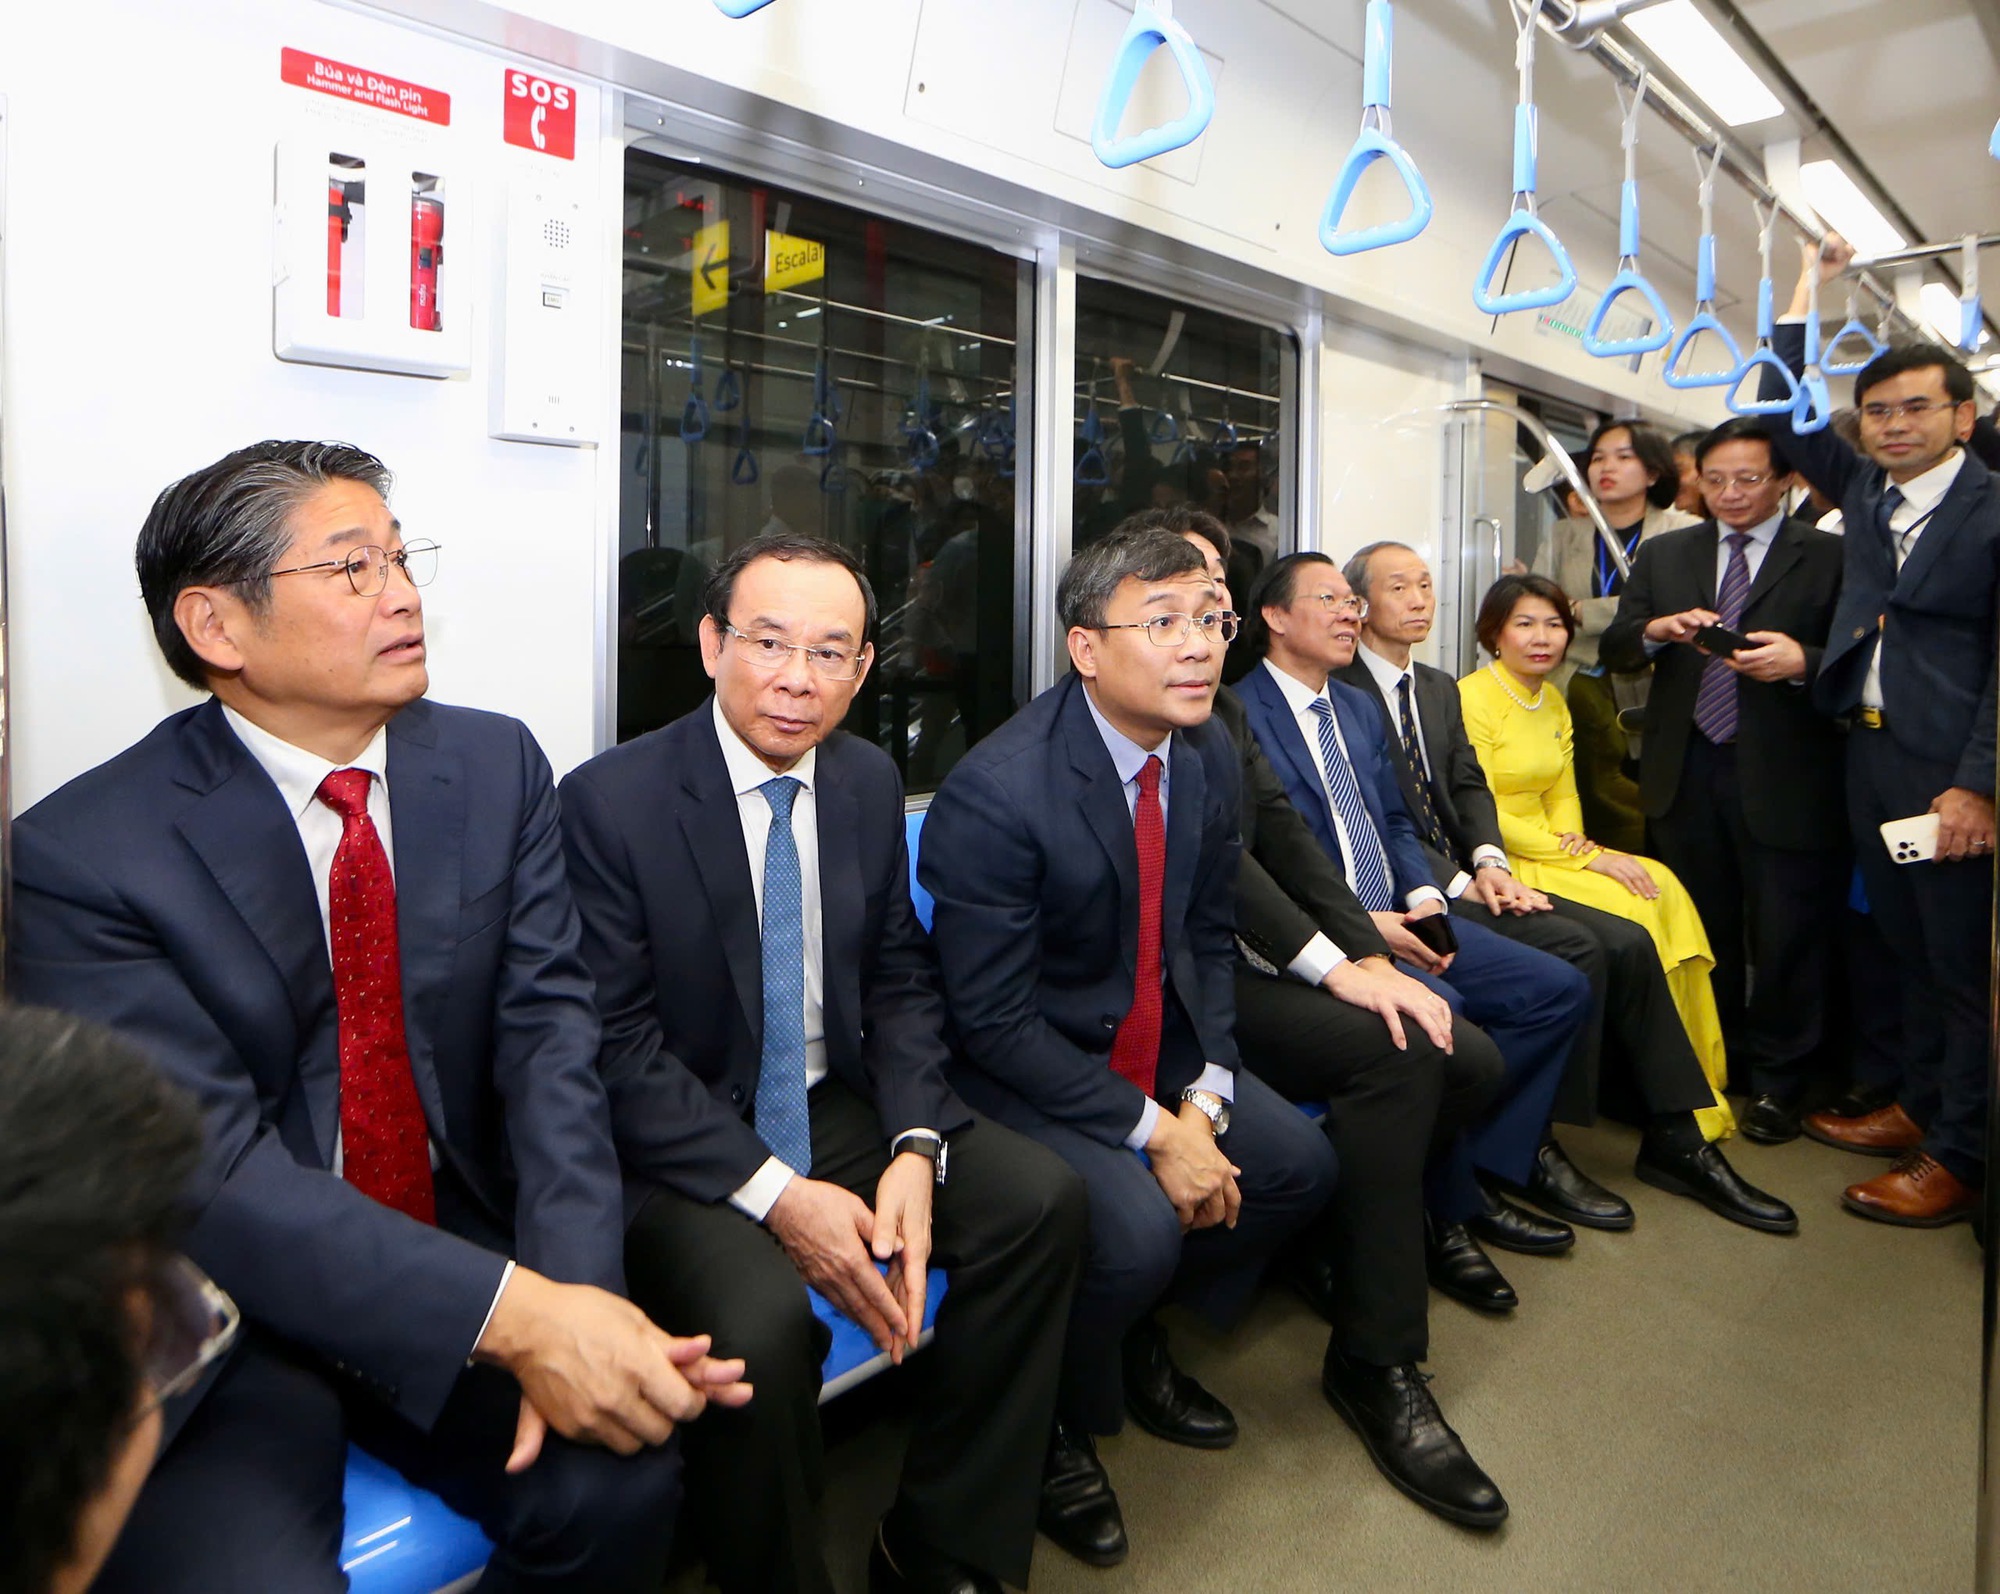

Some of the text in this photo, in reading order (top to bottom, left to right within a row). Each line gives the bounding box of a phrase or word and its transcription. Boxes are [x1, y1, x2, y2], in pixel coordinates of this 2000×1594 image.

[306, 73, 428, 117] Hammer and Flash Light
[399, 87, 422, 104] pin
[511, 73, 570, 111] SOS
